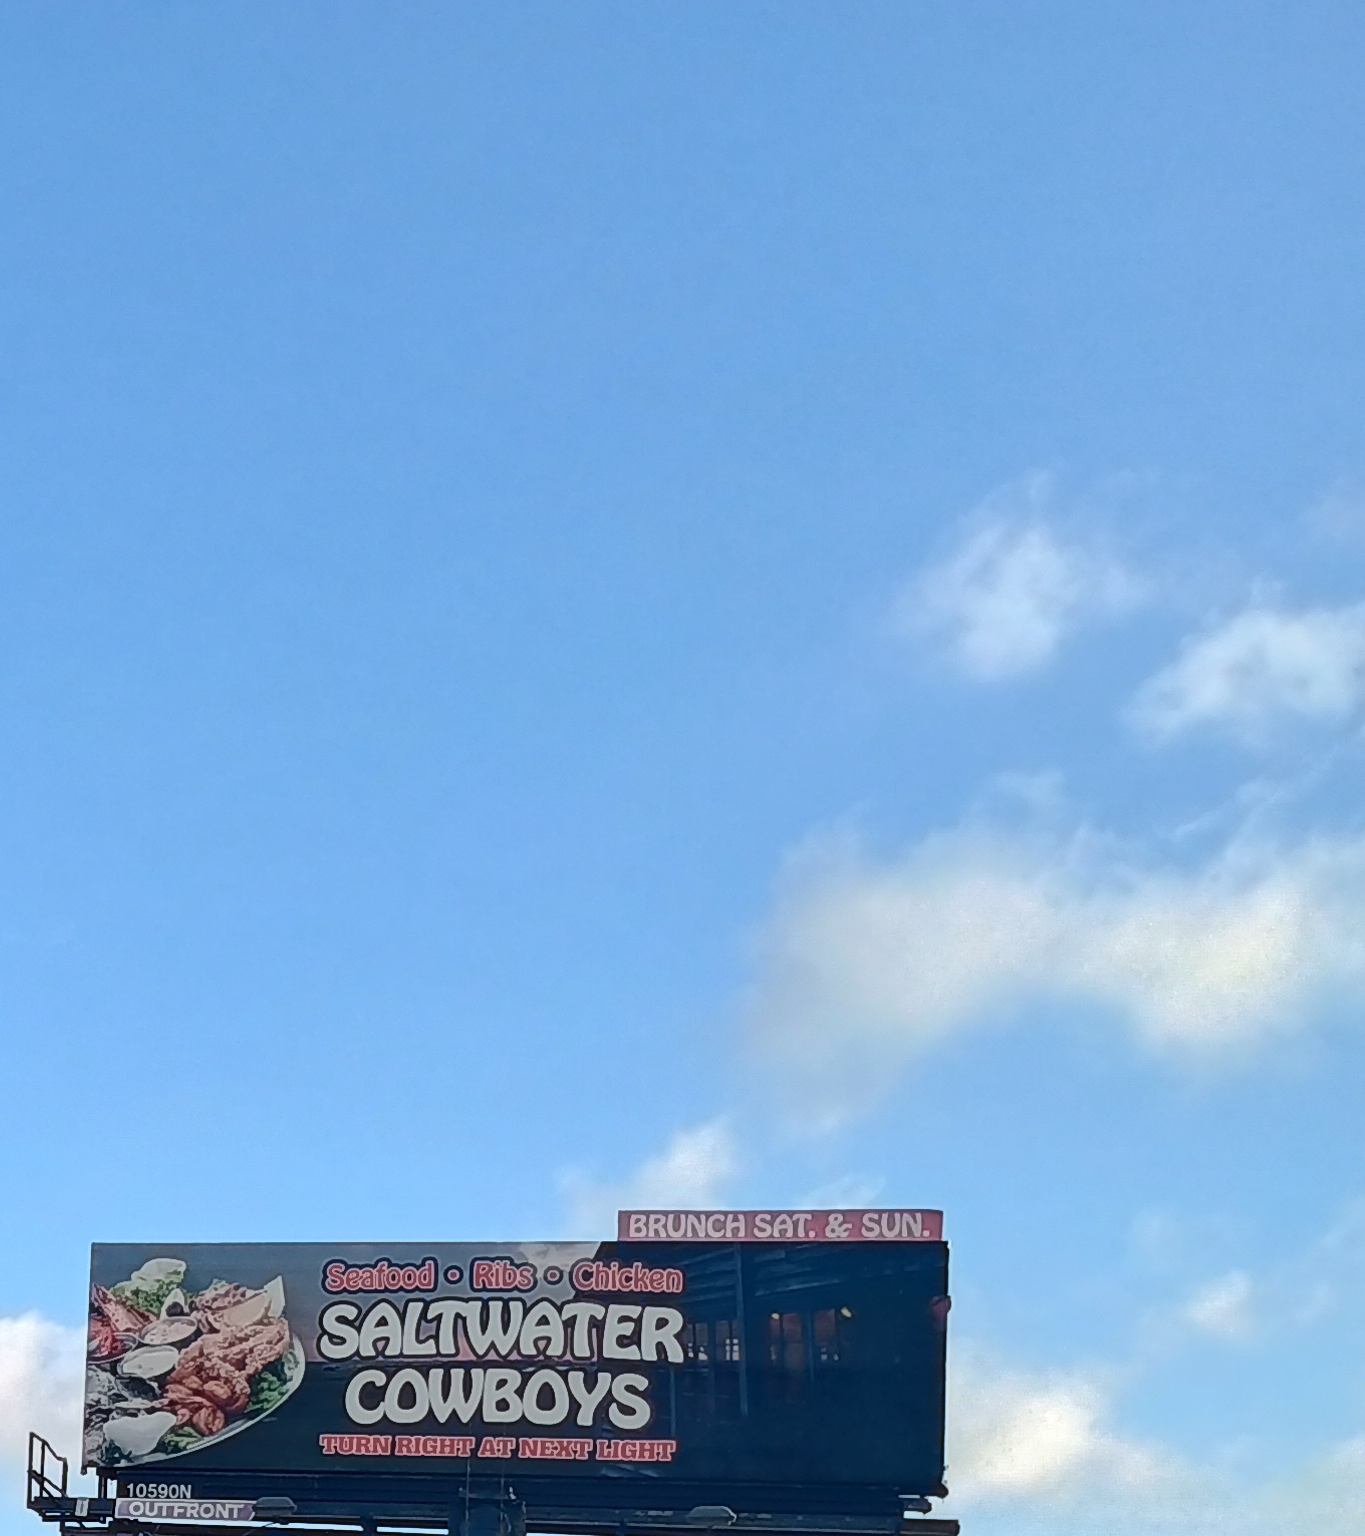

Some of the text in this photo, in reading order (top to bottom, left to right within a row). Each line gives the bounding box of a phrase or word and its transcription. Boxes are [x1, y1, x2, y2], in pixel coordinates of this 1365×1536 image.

[628, 1213, 746, 1239] BRUNCH
[753, 1213, 816, 1239] SAT.
[861, 1212, 931, 1238] SUN.
[325, 1260, 684, 1293] Seafood Ribs Chicken
[320, 1300, 684, 1364] SALTWATER
[345, 1367, 652, 1430] COWBOYS
[319, 1434, 677, 1462] TURN RIGHT AT NEXT LIGHT
[126, 1483, 192, 1499] 10590N
[128, 1501, 245, 1519] OUTFRONT
